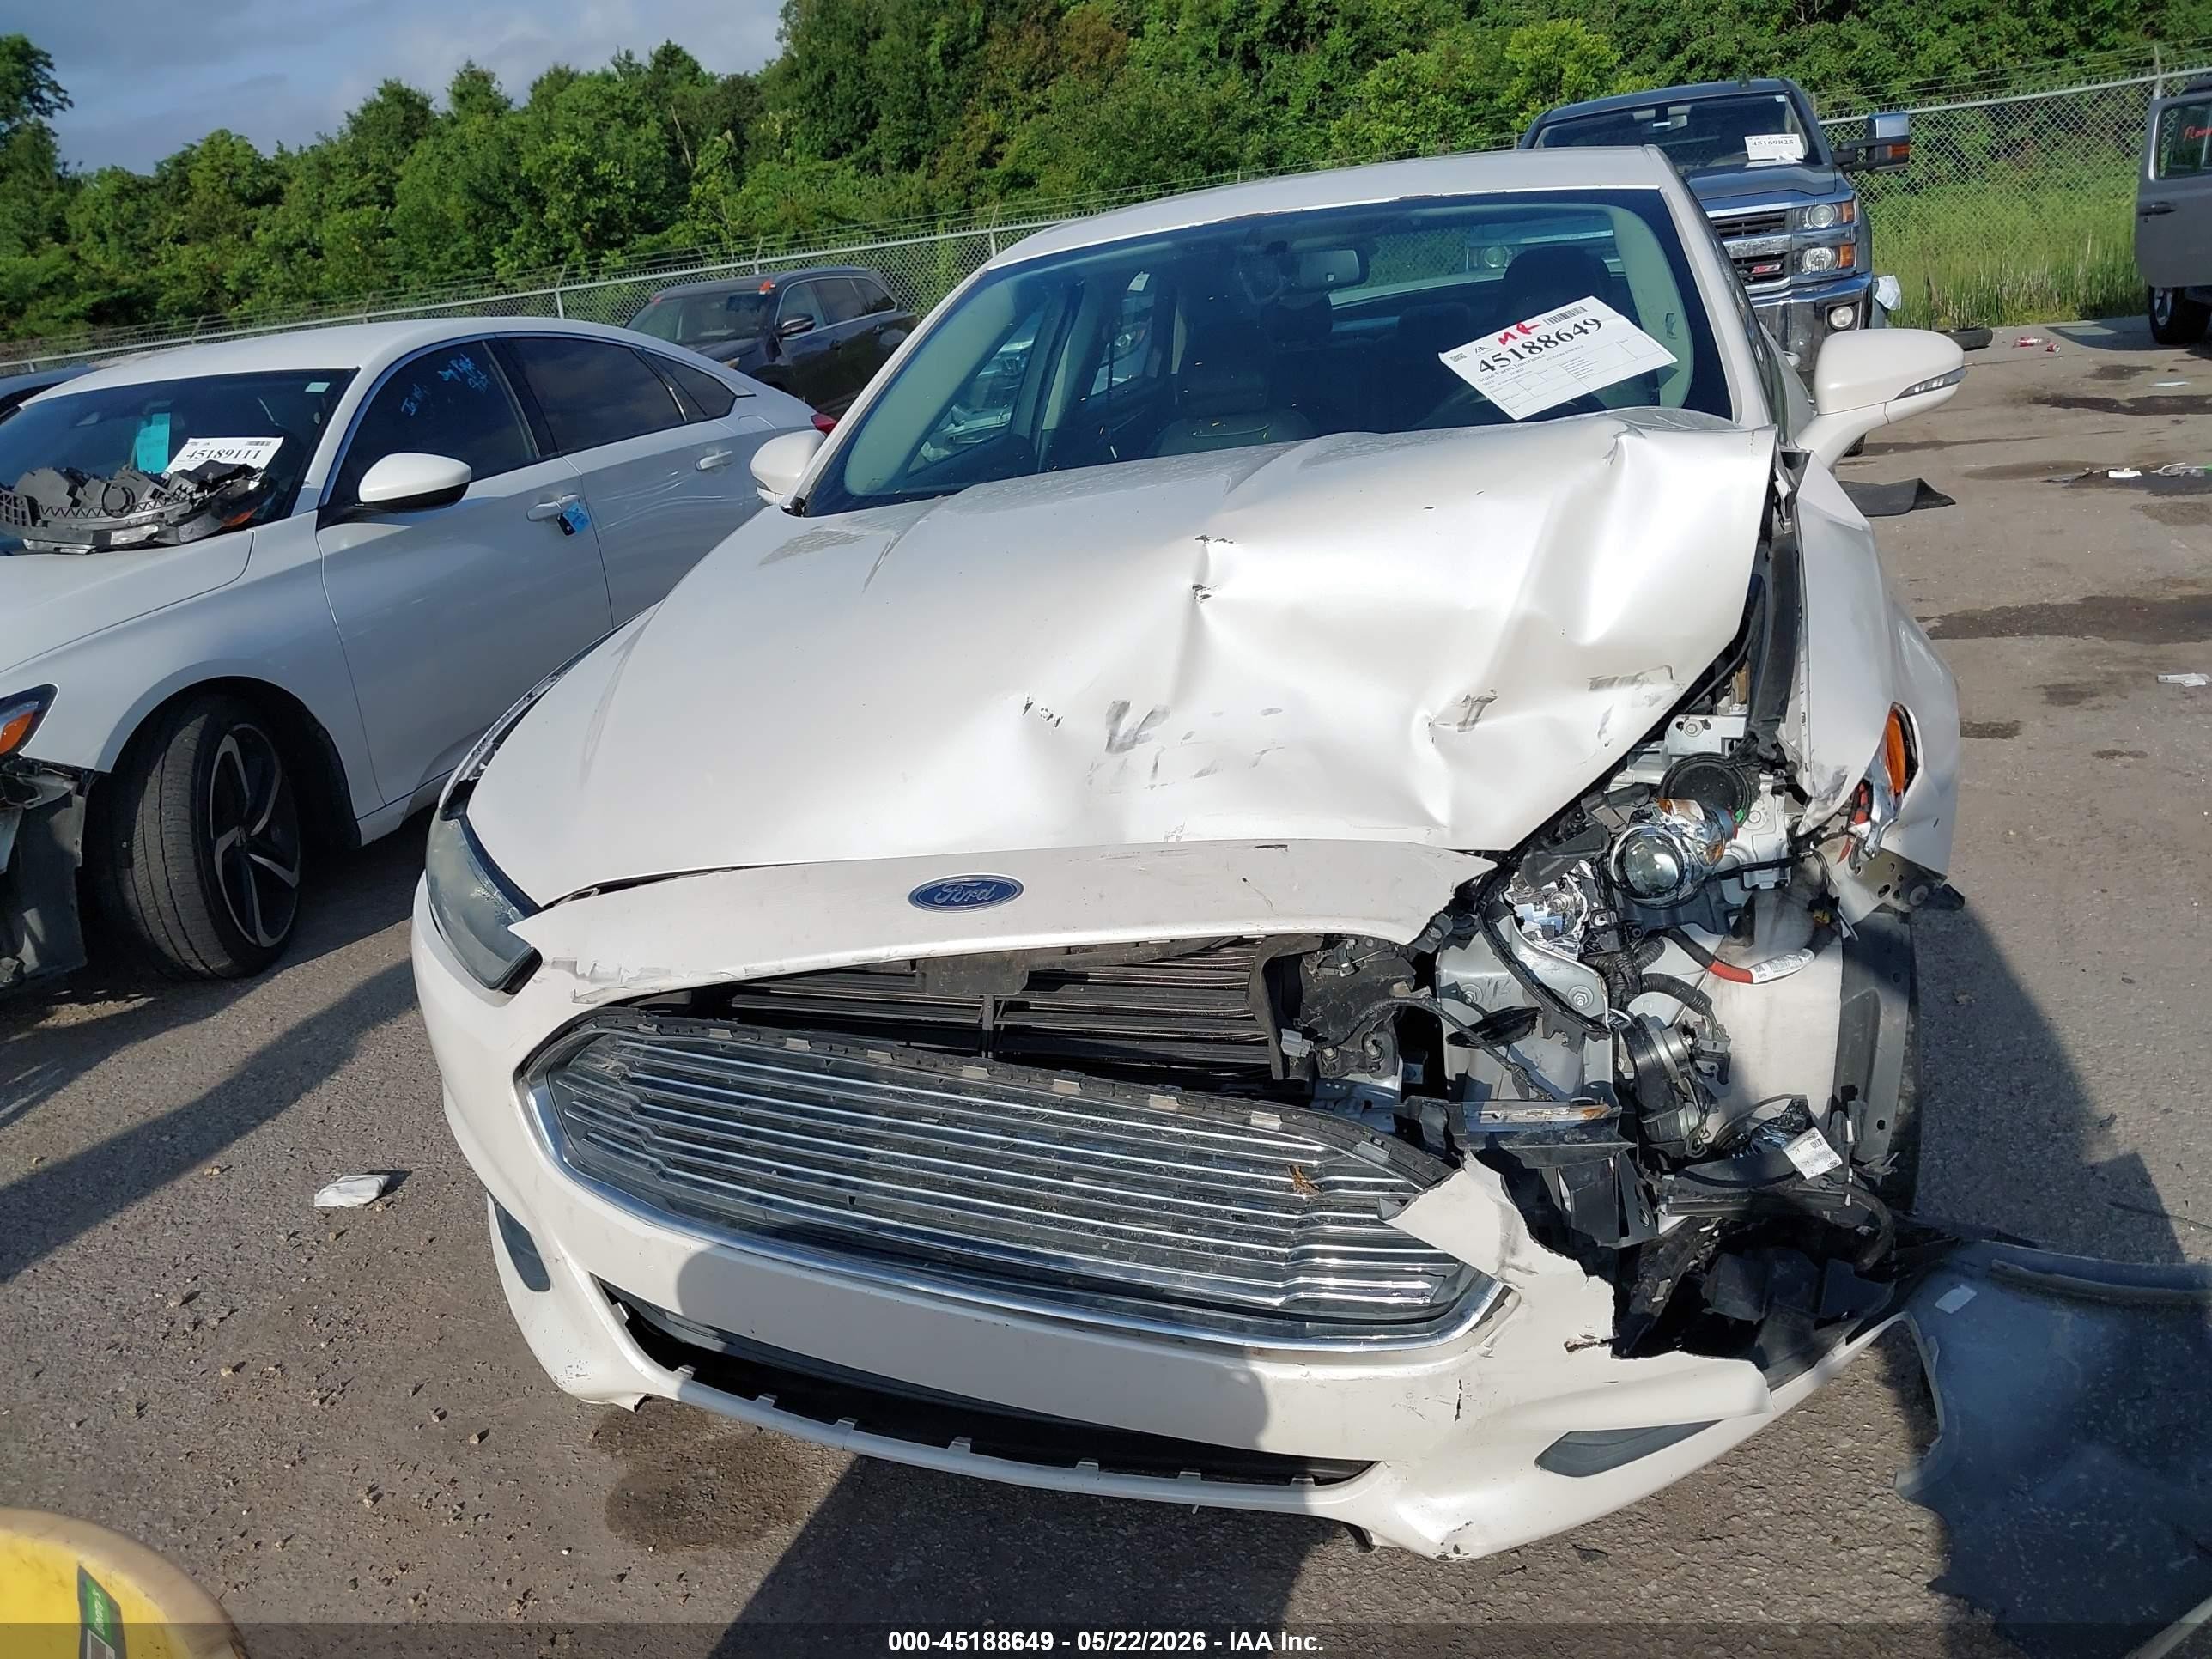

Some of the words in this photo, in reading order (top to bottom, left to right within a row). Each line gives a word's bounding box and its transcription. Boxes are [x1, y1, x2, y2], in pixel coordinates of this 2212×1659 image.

[1480, 318, 1601, 373] 45188649
[186, 448, 261, 459] 45189111
[933, 881, 996, 904] Ford
